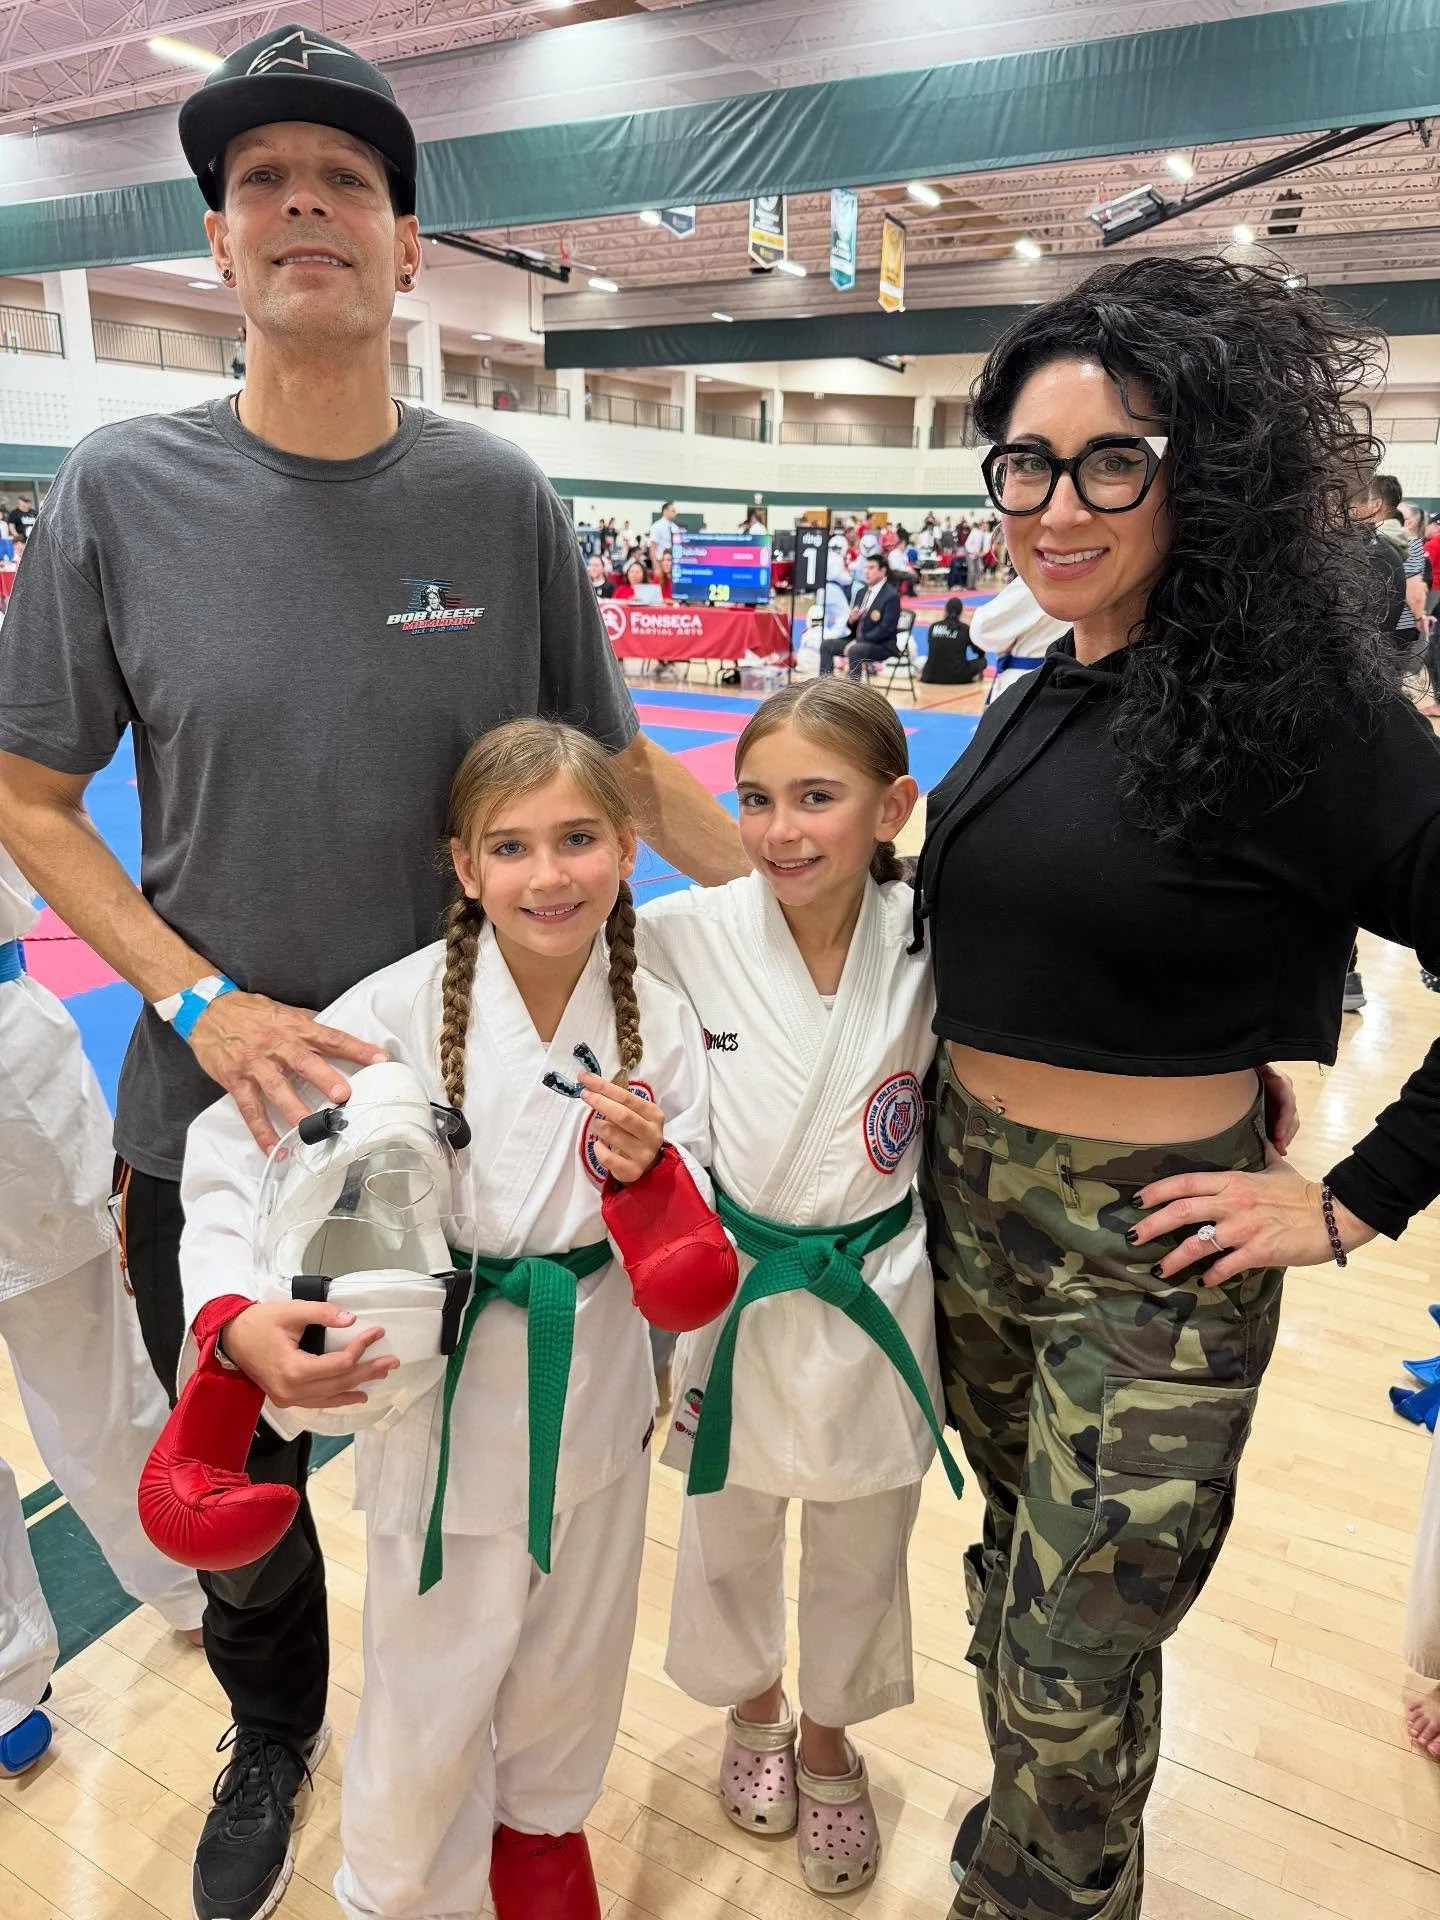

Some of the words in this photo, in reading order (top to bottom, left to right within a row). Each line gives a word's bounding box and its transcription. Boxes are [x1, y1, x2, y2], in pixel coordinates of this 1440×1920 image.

[803, 547, 817, 585] 1
[386, 611, 427, 625] BOB
[429, 608, 485, 620] REESE
[402, 617, 475, 631] MEMORIAL
[630, 612, 702, 628] FONSECA
[868, 1105, 879, 1136] AMATEUR
[877, 1082, 898, 1105] ATHLETIC
